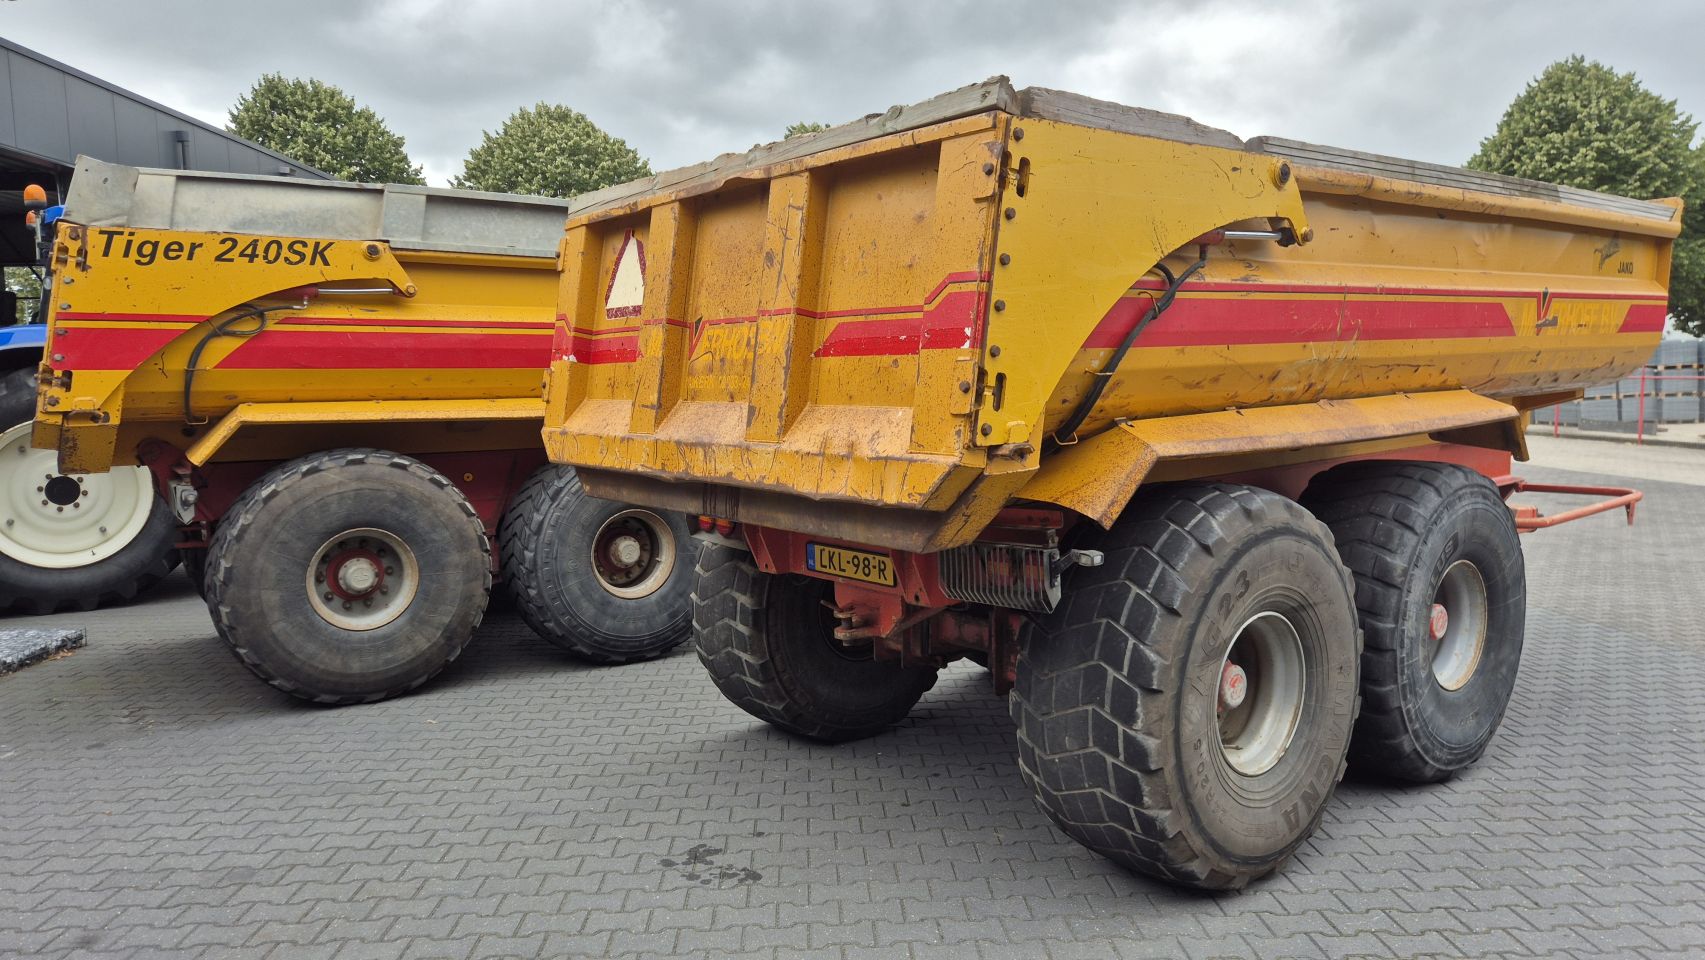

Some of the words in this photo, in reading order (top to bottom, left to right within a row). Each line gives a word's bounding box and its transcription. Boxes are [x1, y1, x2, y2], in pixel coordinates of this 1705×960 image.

[98, 229, 203, 266] Tiger
[214, 237, 336, 267] 240SK
[1617, 261, 1633, 274] JAKO
